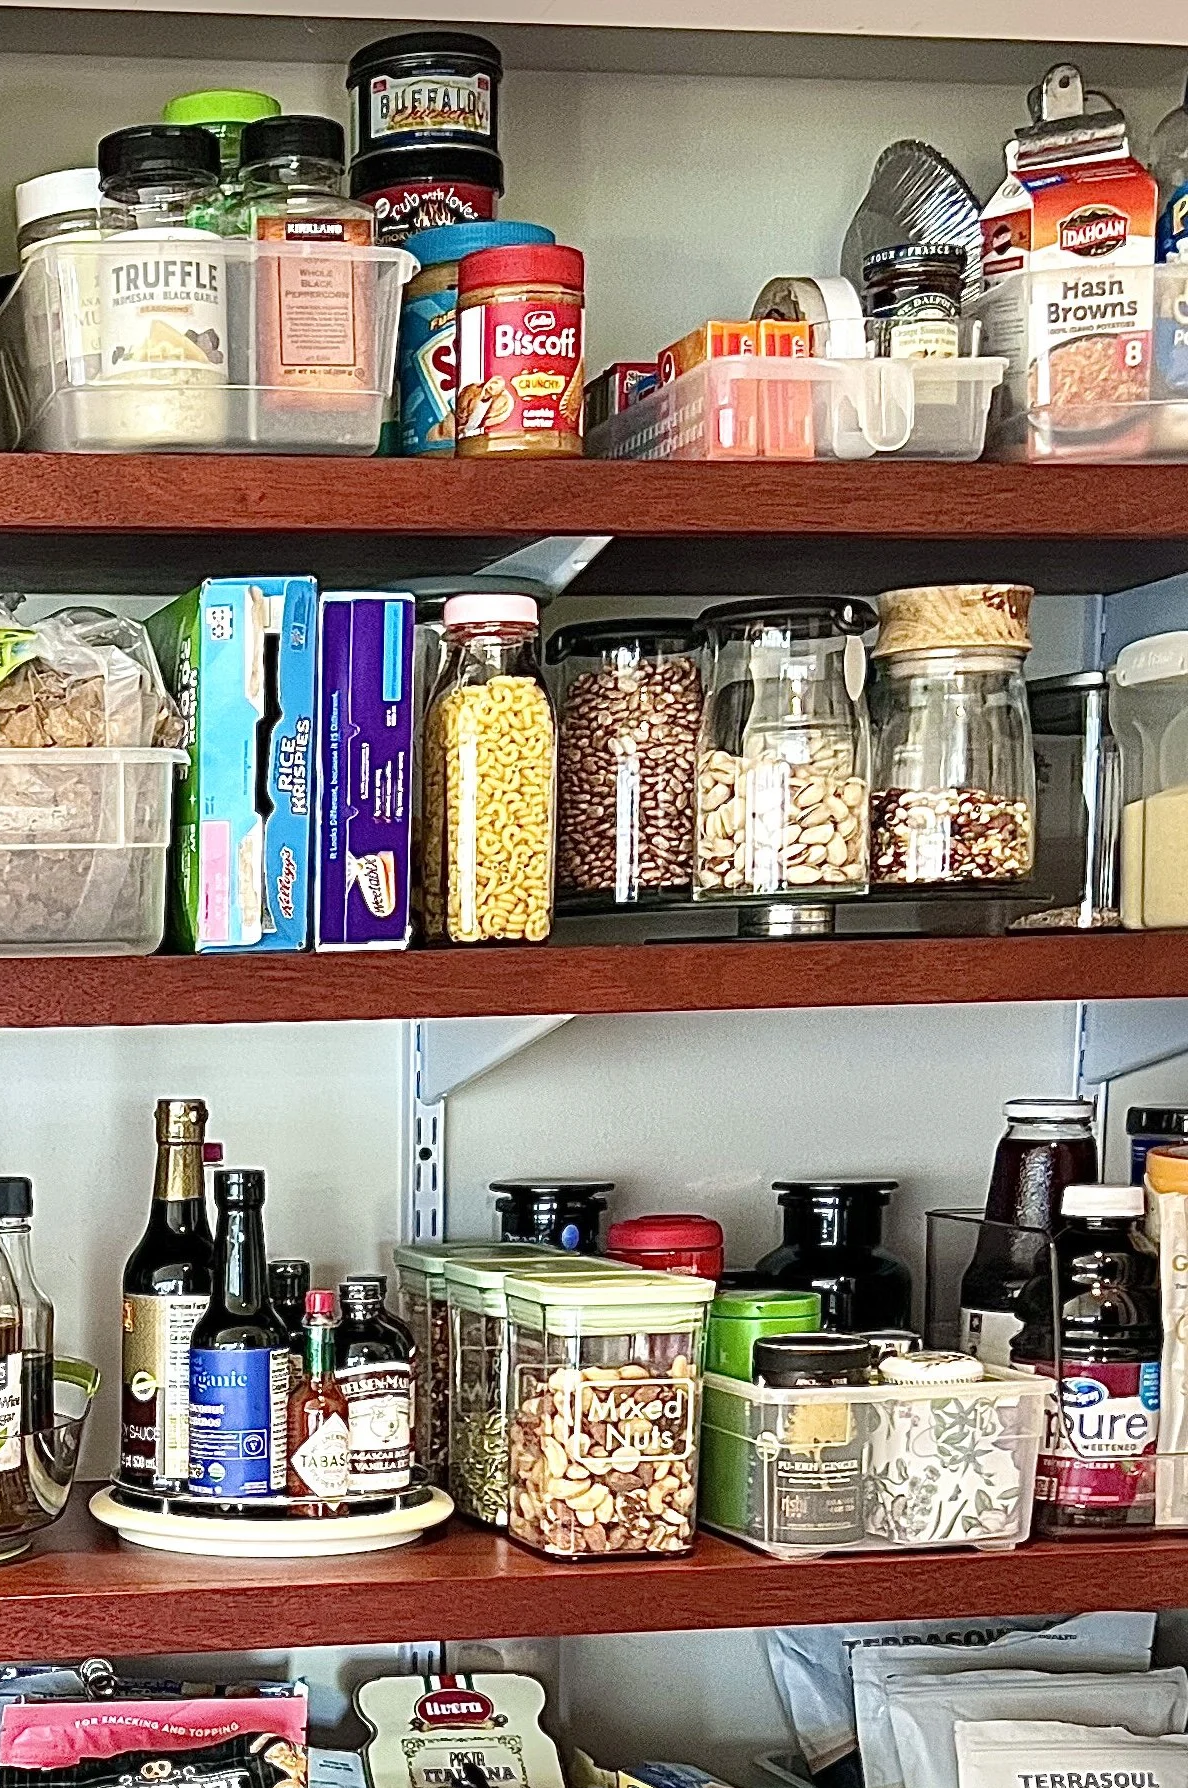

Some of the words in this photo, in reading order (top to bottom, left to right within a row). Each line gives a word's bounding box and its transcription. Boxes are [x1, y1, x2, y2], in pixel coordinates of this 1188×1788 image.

[381, 88, 476, 119] BUFFALO
[288, 223, 342, 235] KIRKLAND
[1063, 220, 1124, 247] IDAHOAN
[112, 260, 218, 293] TRUFFLE
[301, 279, 332, 288] BLACK
[164, 290, 190, 301] BLACK
[1048, 300, 1137, 323] Browns
[495, 325, 575, 358] Biscoff
[1124, 340, 1142, 367] 8
[519, 379, 560, 389] CRUNCHY
[278, 737, 297, 792] RICE
[291, 718, 311, 816] KRISPIES
[277, 846, 297, 918] Kellogg's
[362, 856, 387, 915] Weetabix
[588, 1390, 682, 1421] Mixed
[129, 1424, 160, 1441] SAUCE
[606, 1425, 673, 1451] Nuts
[1045, 1410, 1148, 1449] pure
[778, 1461, 819, 1471] PU-ERH
[821, 1460, 858, 1470] GINGER
[75, 1716, 98, 1728] FOR
[102, 1716, 160, 1730] SNACKING
[162, 1723, 186, 1736] AND
[189, 1722, 240, 1738] TOPPING
[449, 1752, 485, 1767] PASTA
